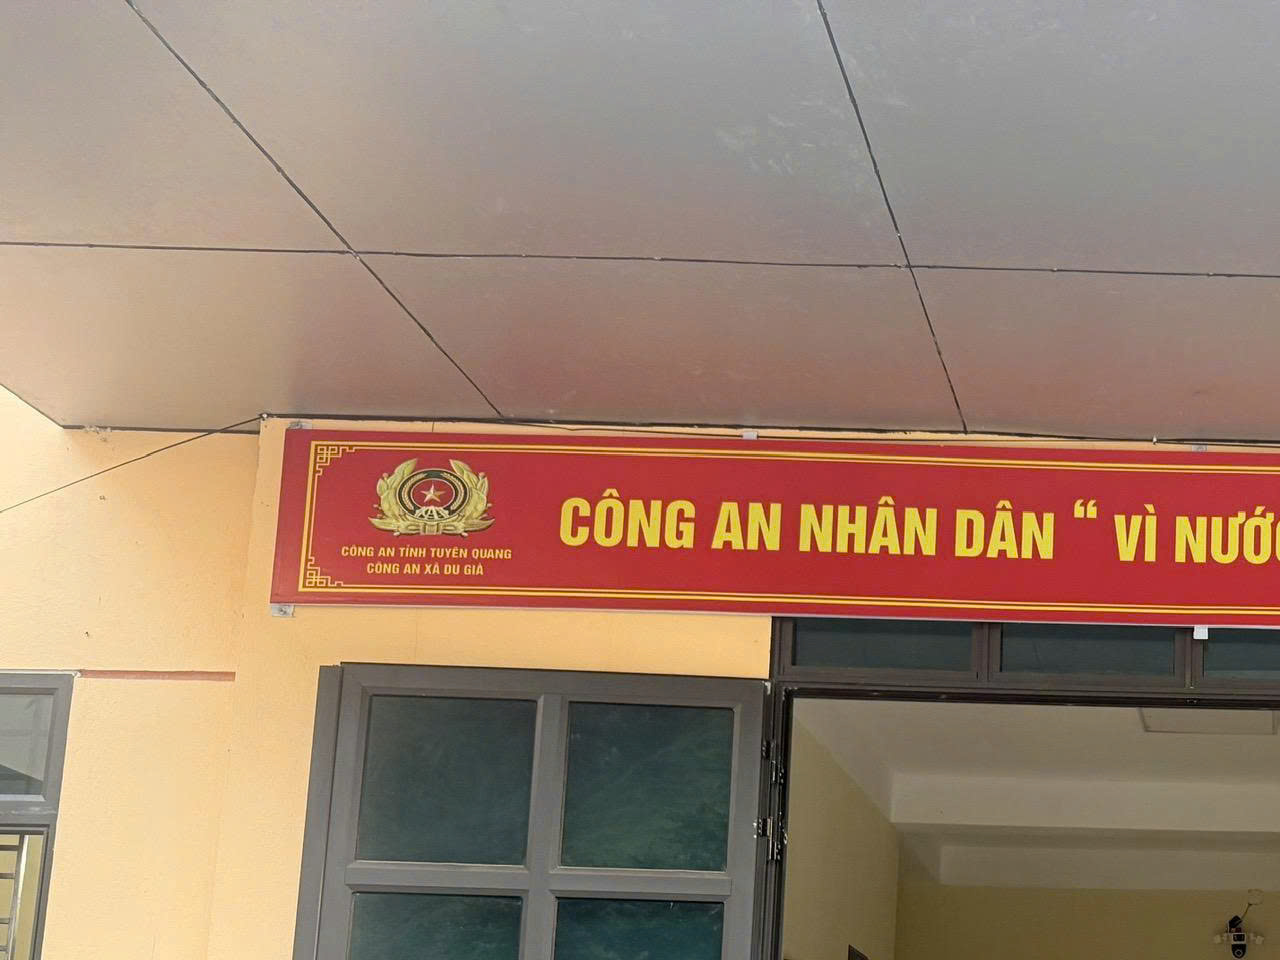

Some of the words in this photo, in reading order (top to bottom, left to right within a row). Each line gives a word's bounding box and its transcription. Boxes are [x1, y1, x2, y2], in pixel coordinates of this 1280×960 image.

[559, 488, 696, 549] CÔNG
[711, 501, 782, 551] AN
[798, 495, 938, 556] NHÂN
[954, 499, 1055, 560] DÂN
[1113, 503, 1157, 562] VÌ
[341, 544, 374, 557] CÔNG
[378, 547, 395, 557] AN
[399, 544, 426, 558] TỈNH
[430, 545, 468, 559] TUYÊN
[471, 548, 512, 560] QUANG
[367, 562, 400, 574] CÔNG
[403, 563, 420, 574] AN
